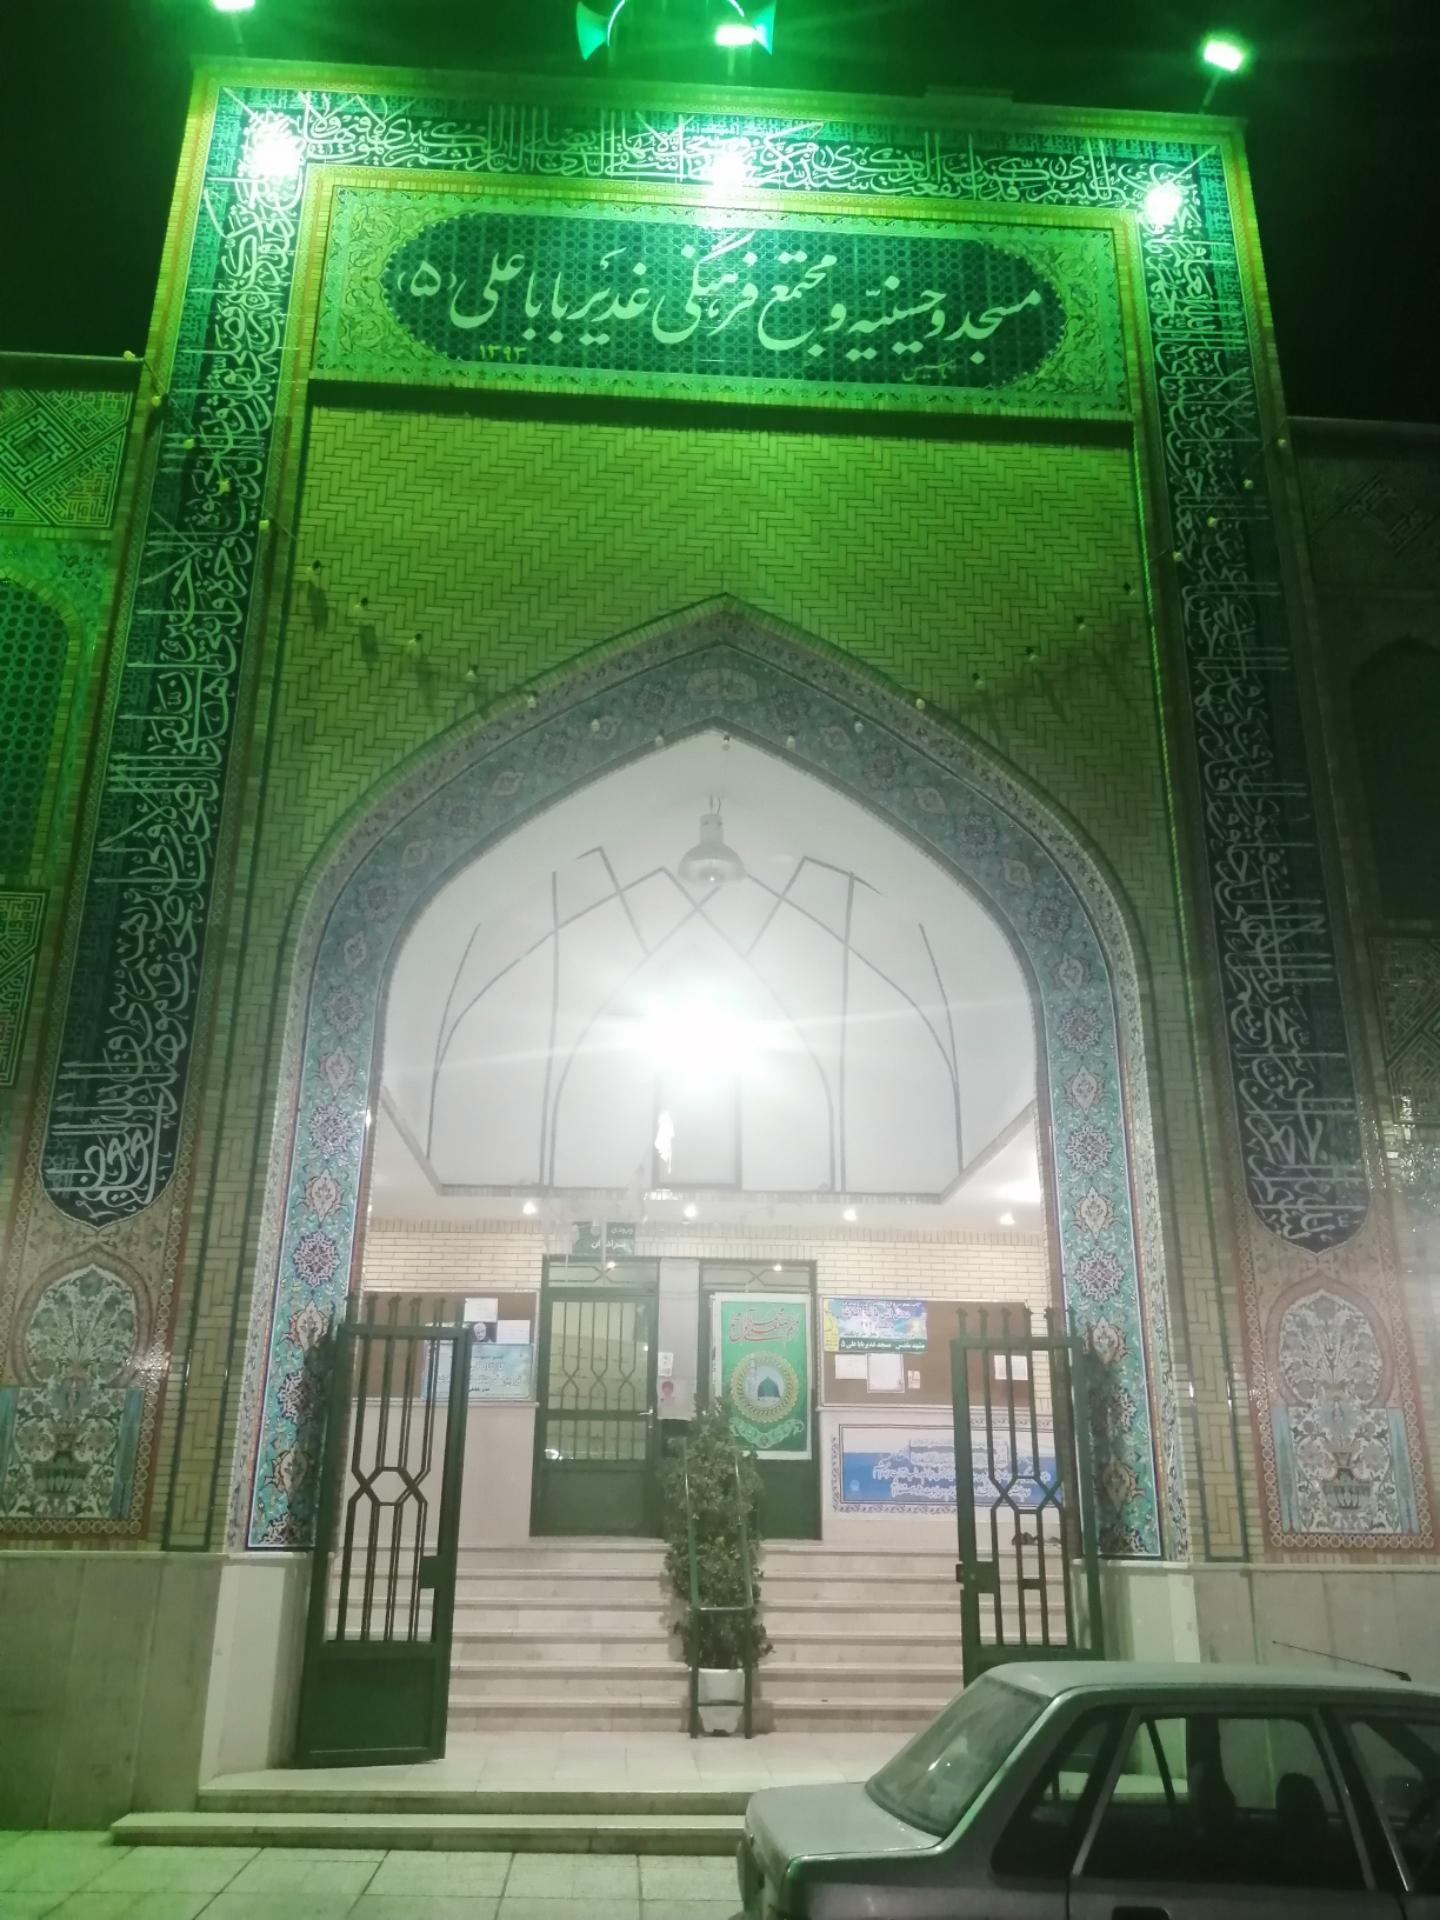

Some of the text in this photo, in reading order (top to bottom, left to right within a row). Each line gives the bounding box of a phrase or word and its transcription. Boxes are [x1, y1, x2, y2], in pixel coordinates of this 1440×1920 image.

[566, 250, 652, 346] غدیر
[652, 231, 758, 344] فرهنگی
[757, 251, 837, 357] مجتمع
[943, 289, 1041, 365] مسجد
